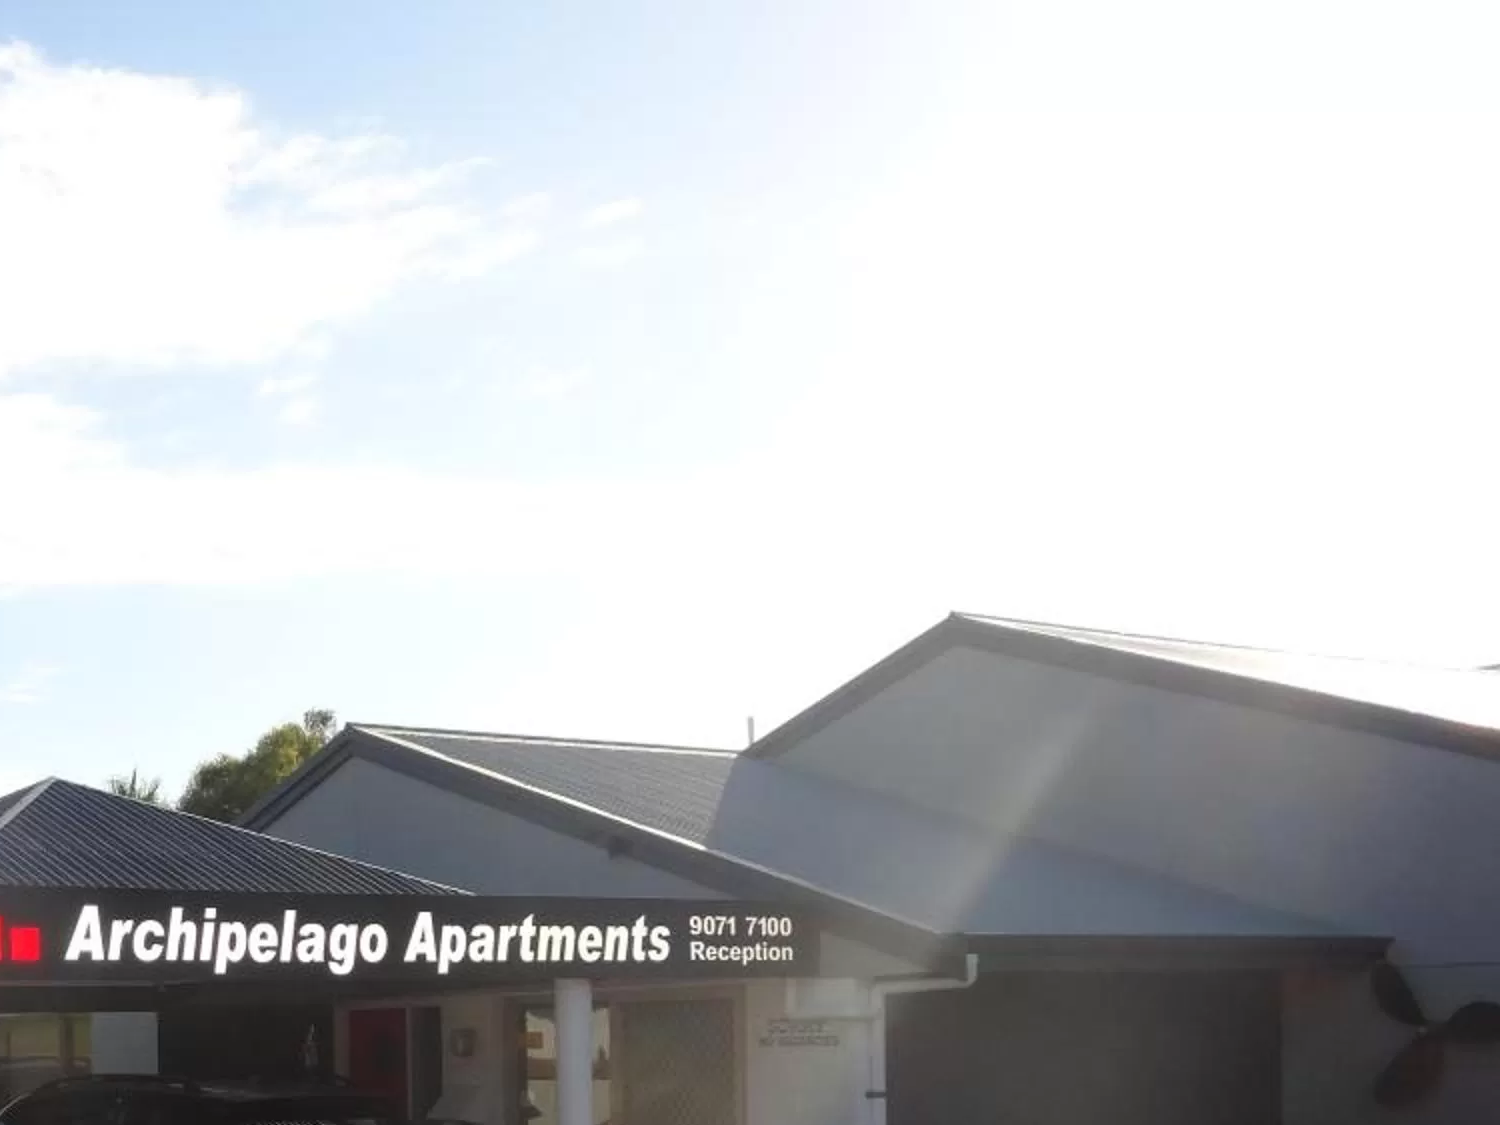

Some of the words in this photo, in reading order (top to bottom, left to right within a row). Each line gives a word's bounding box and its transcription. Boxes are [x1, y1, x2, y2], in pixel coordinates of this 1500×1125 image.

[689, 915, 737, 937] 9071
[745, 916, 793, 937] 7100
[64, 904, 389, 976] Archipelago
[403, 911, 672, 975] Apartments
[689, 941, 795, 966] Reception
